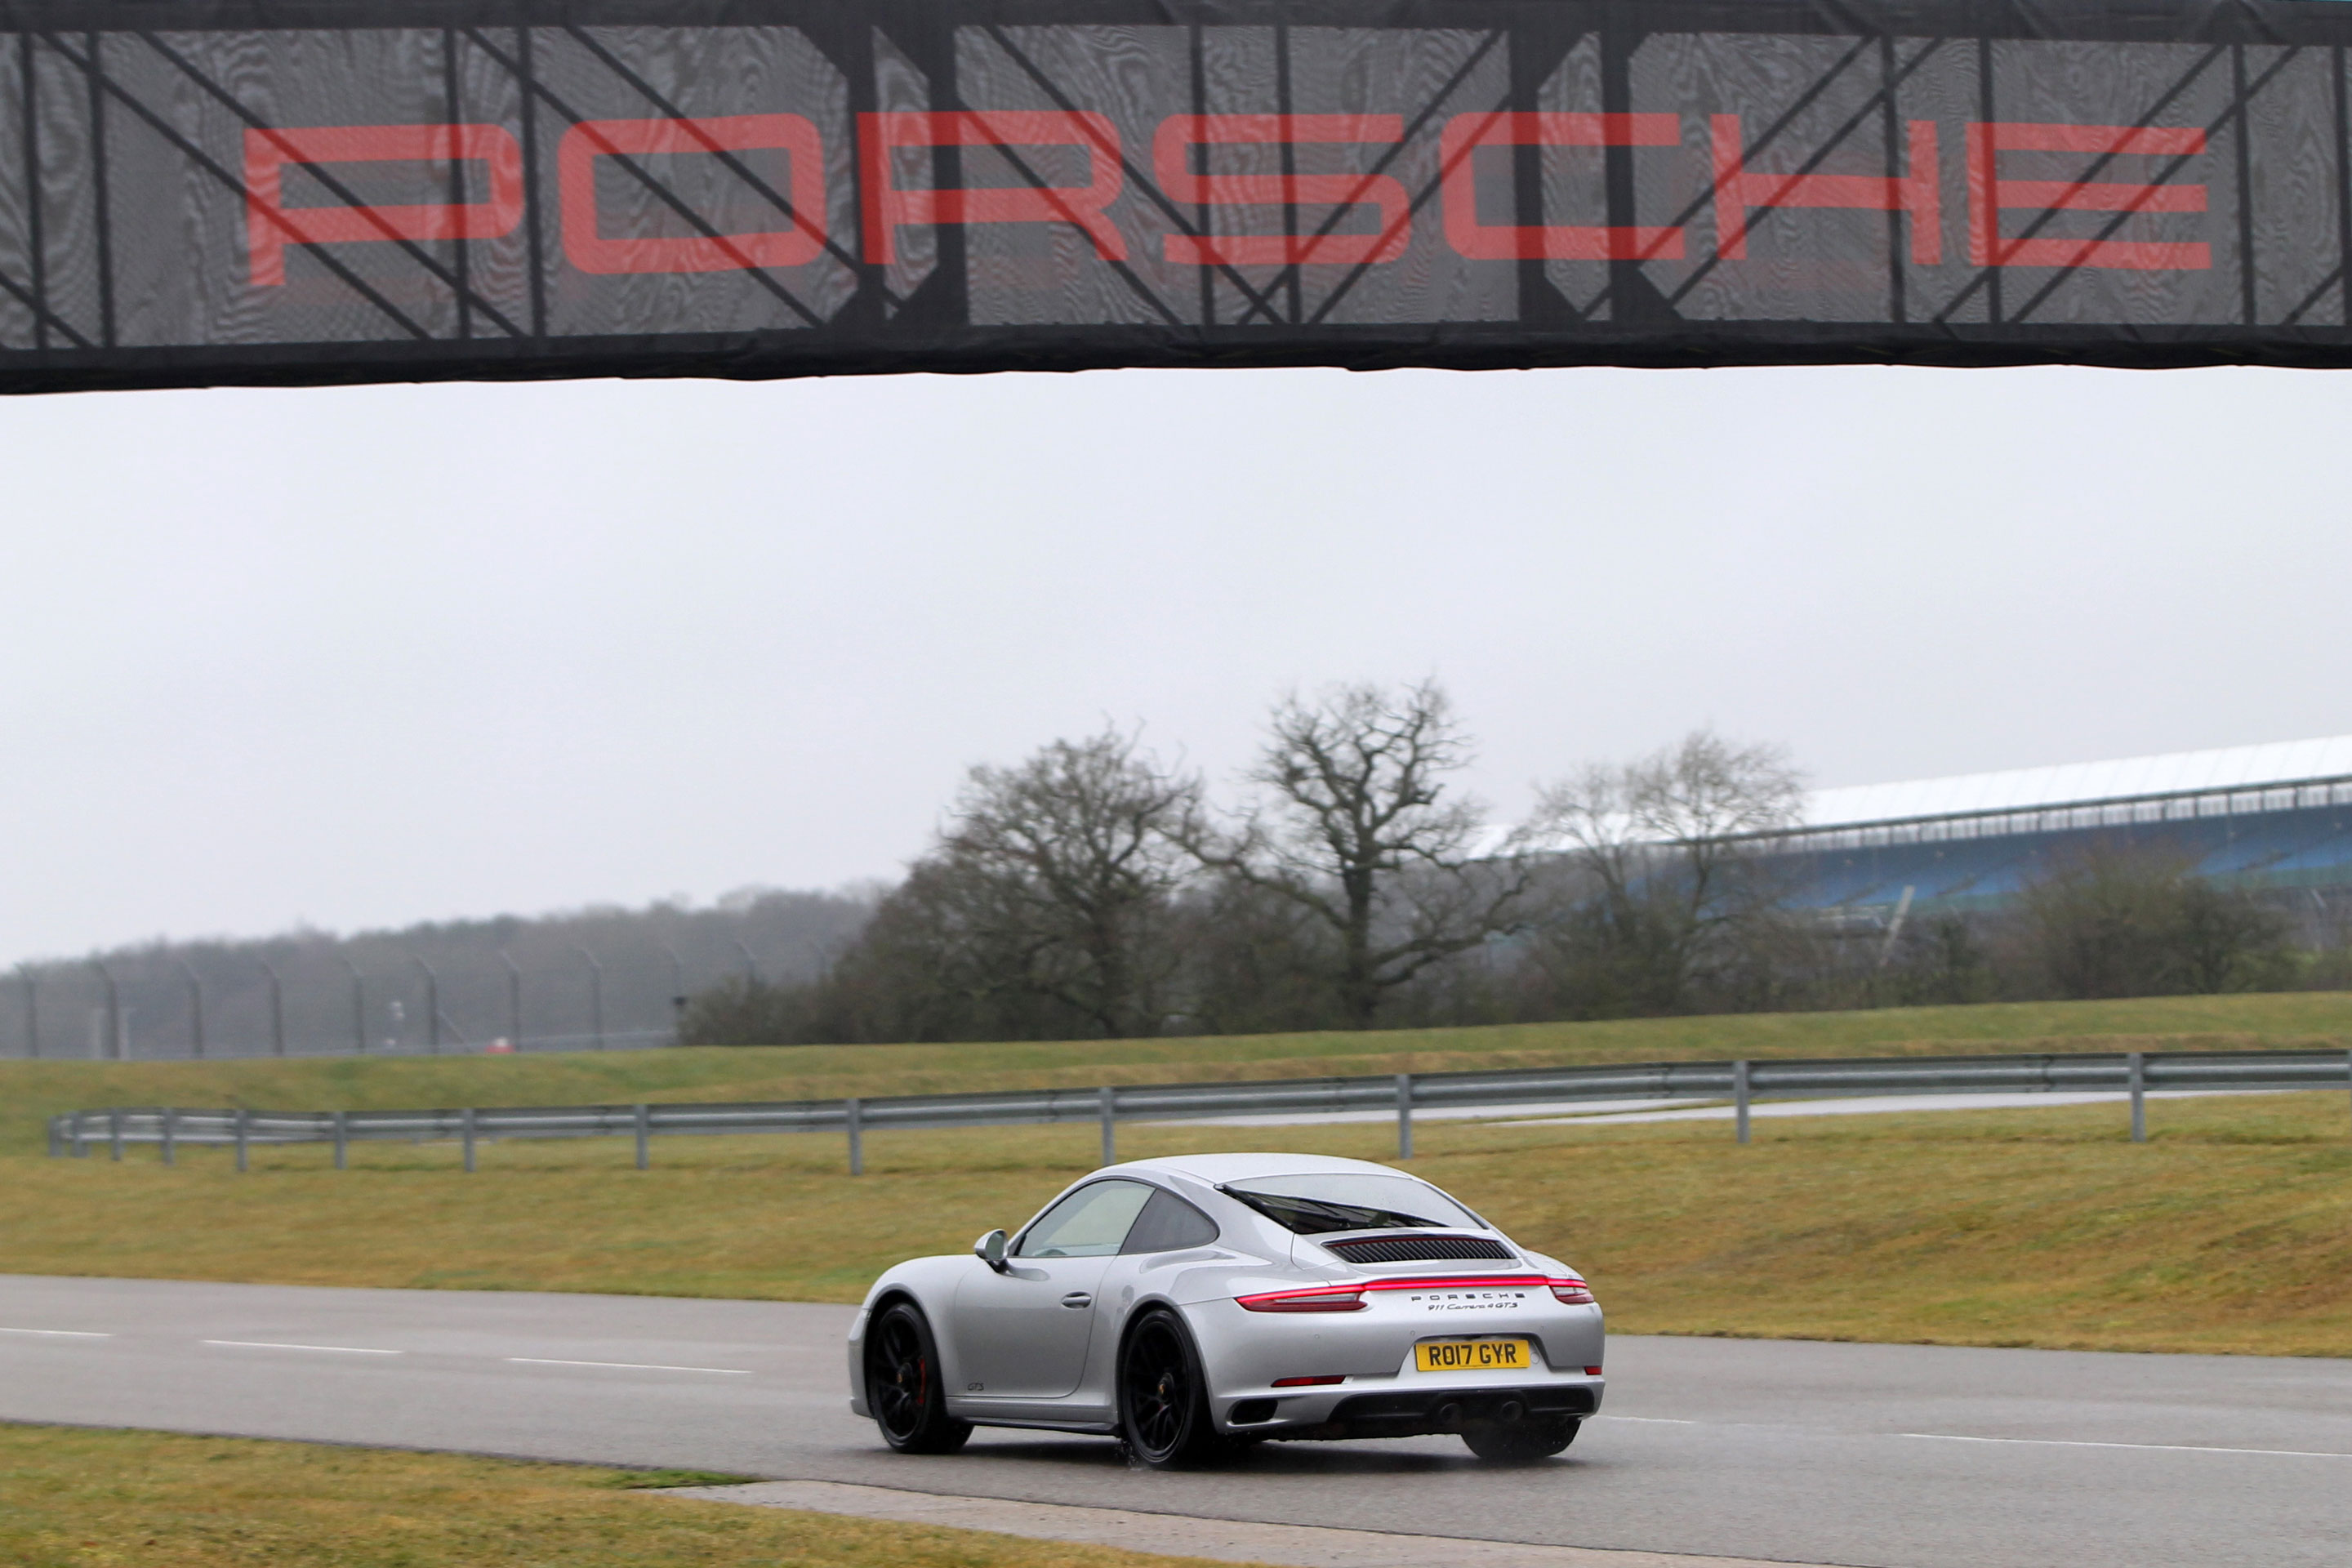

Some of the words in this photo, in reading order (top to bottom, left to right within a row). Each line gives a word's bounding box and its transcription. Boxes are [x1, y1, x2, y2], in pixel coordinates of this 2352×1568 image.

[243, 109, 2212, 287] PORSCHE
[1410, 1292, 1526, 1302] PORSCHE
[1447, 1303, 1486, 1311] Carrera
[1428, 1344, 1473, 1366] RO17
[1479, 1343, 1517, 1365] GYR
[967, 1382, 985, 1392] GTS
